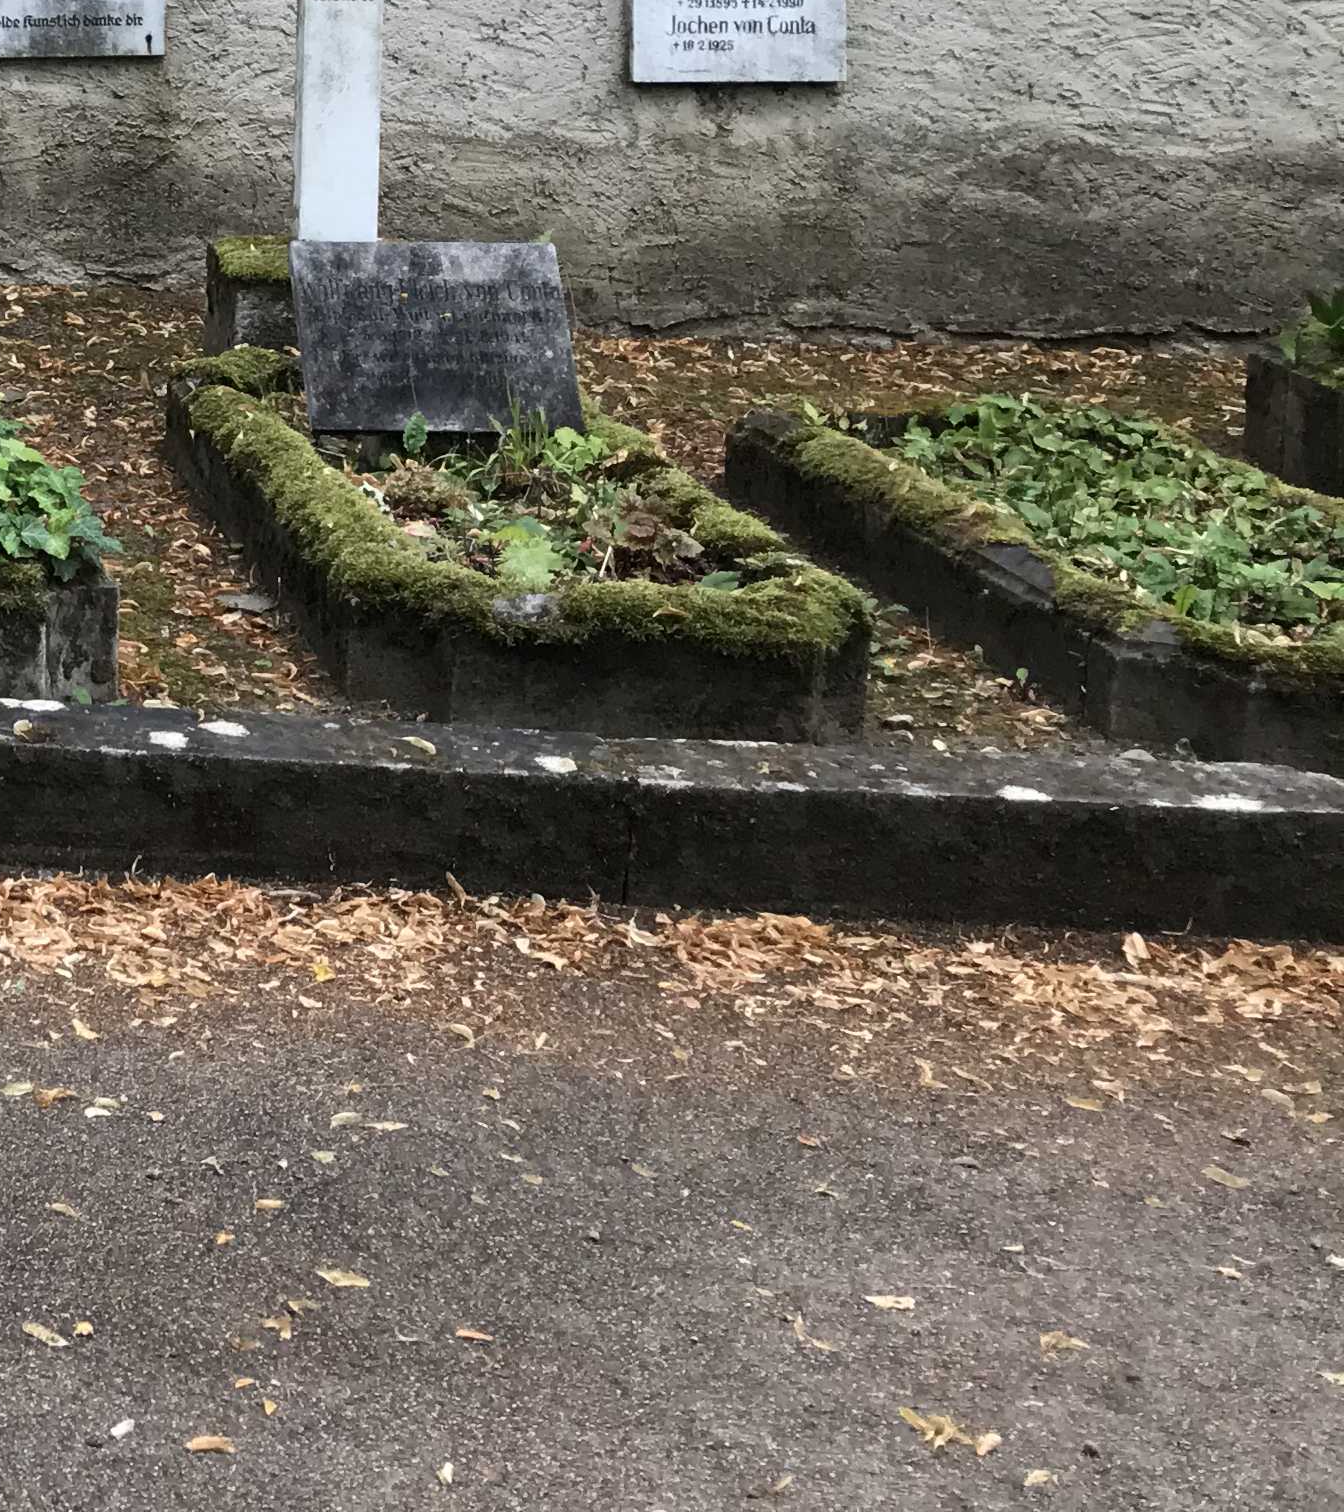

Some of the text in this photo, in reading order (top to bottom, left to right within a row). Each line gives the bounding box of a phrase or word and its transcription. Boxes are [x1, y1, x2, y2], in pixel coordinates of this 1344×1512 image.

[83, 13, 123, 28] danke
[125, 12, 144, 27] dir
[668, 15, 817, 36] Jochen von Conta
